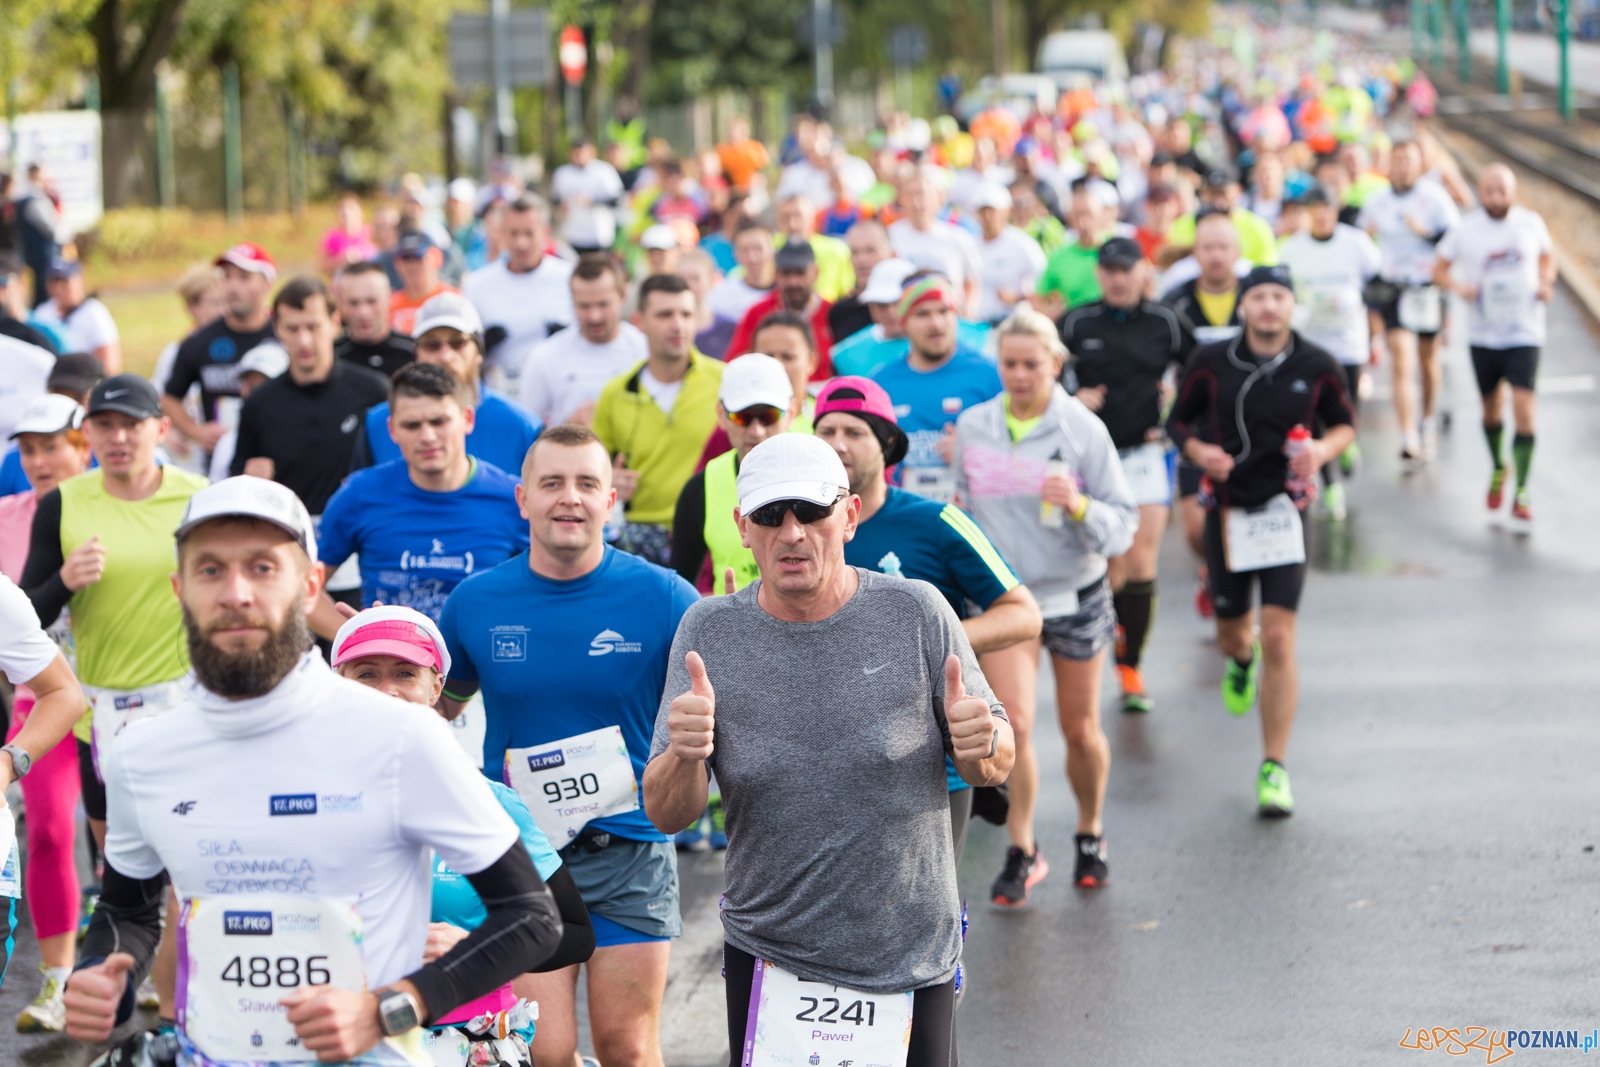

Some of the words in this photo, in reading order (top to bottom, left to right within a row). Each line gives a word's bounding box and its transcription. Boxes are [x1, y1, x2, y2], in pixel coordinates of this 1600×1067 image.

[543, 772, 600, 804] 930
[555, 802, 599, 817] Tomasz
[197, 839, 244, 857] SIŁA
[214, 857, 314, 876] ODWAGA
[205, 876, 317, 894] SZYBKOŚĆ
[221, 955, 331, 987] 4886
[796, 996, 876, 1026] 2241
[811, 1030, 854, 1042] Paweł
